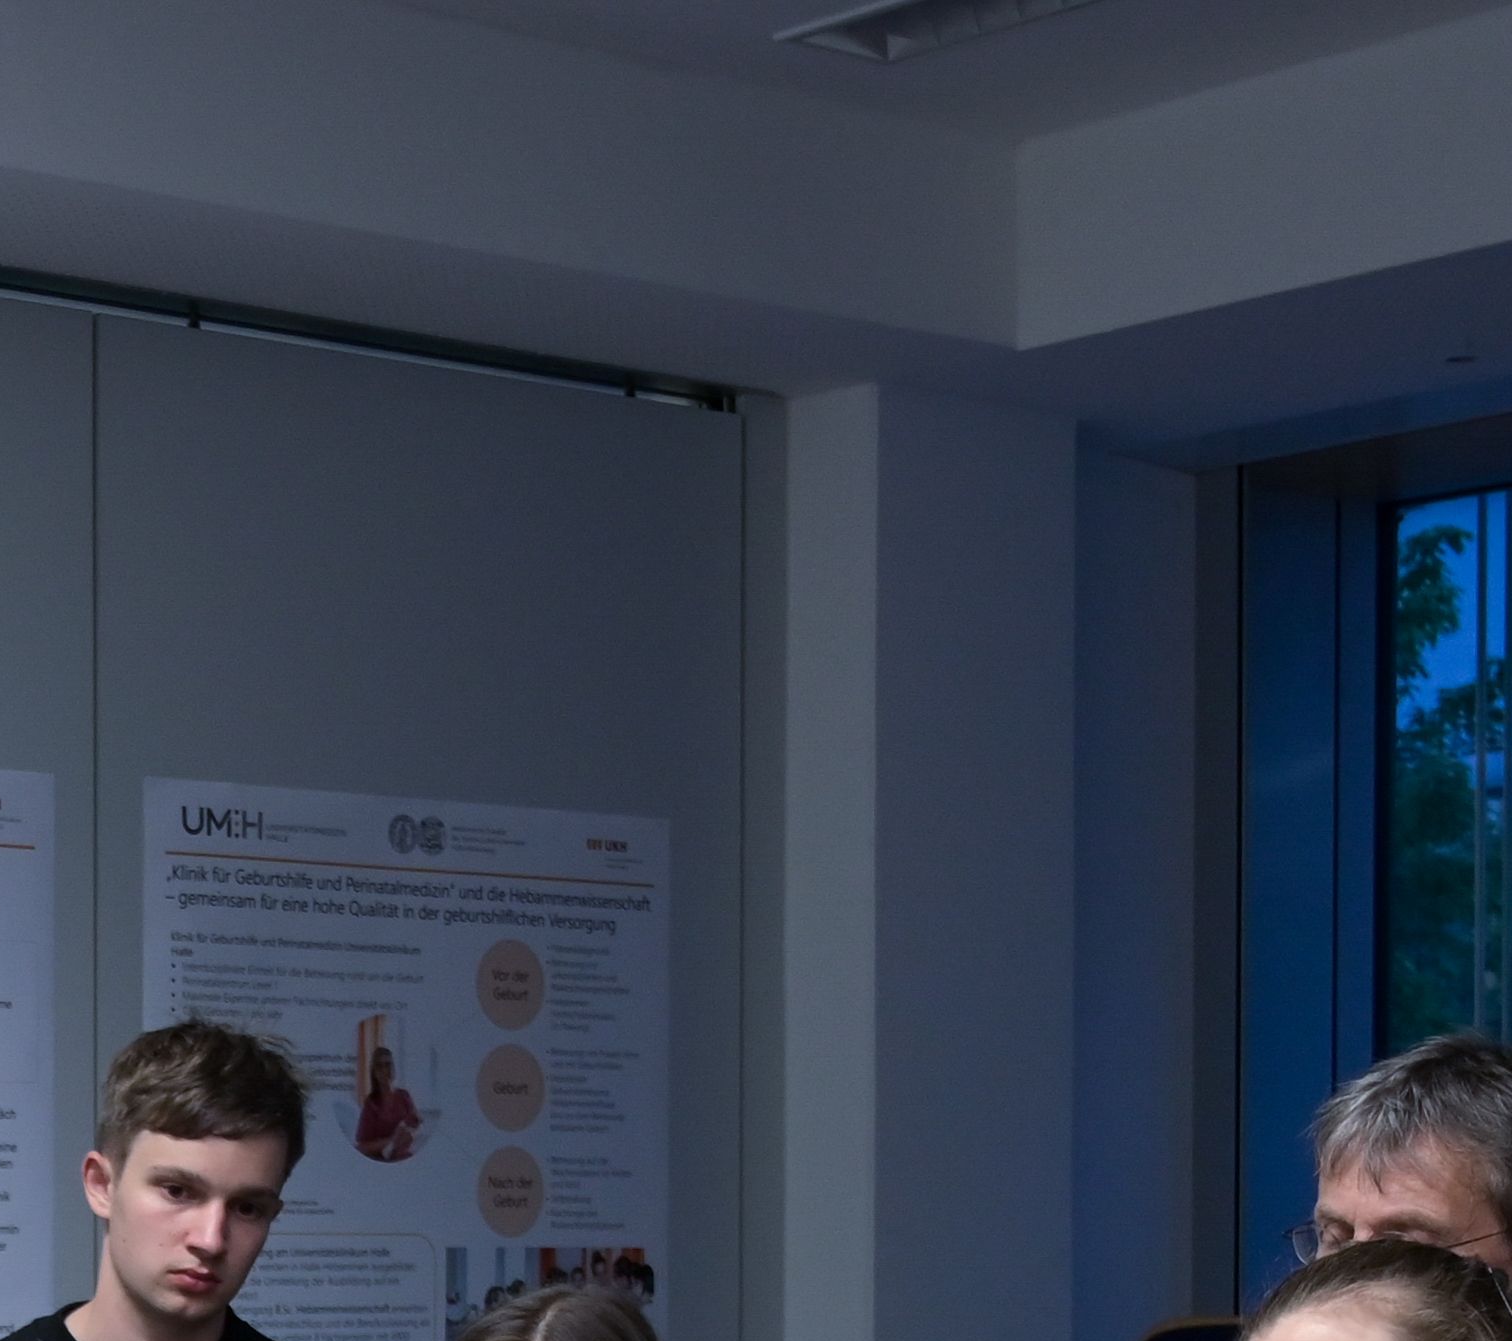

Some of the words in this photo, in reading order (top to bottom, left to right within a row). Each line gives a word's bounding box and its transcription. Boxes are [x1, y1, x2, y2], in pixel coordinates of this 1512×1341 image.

[260, 893, 277, 910] für
[402, 904, 414, 918] in
[418, 905, 440, 920] der
